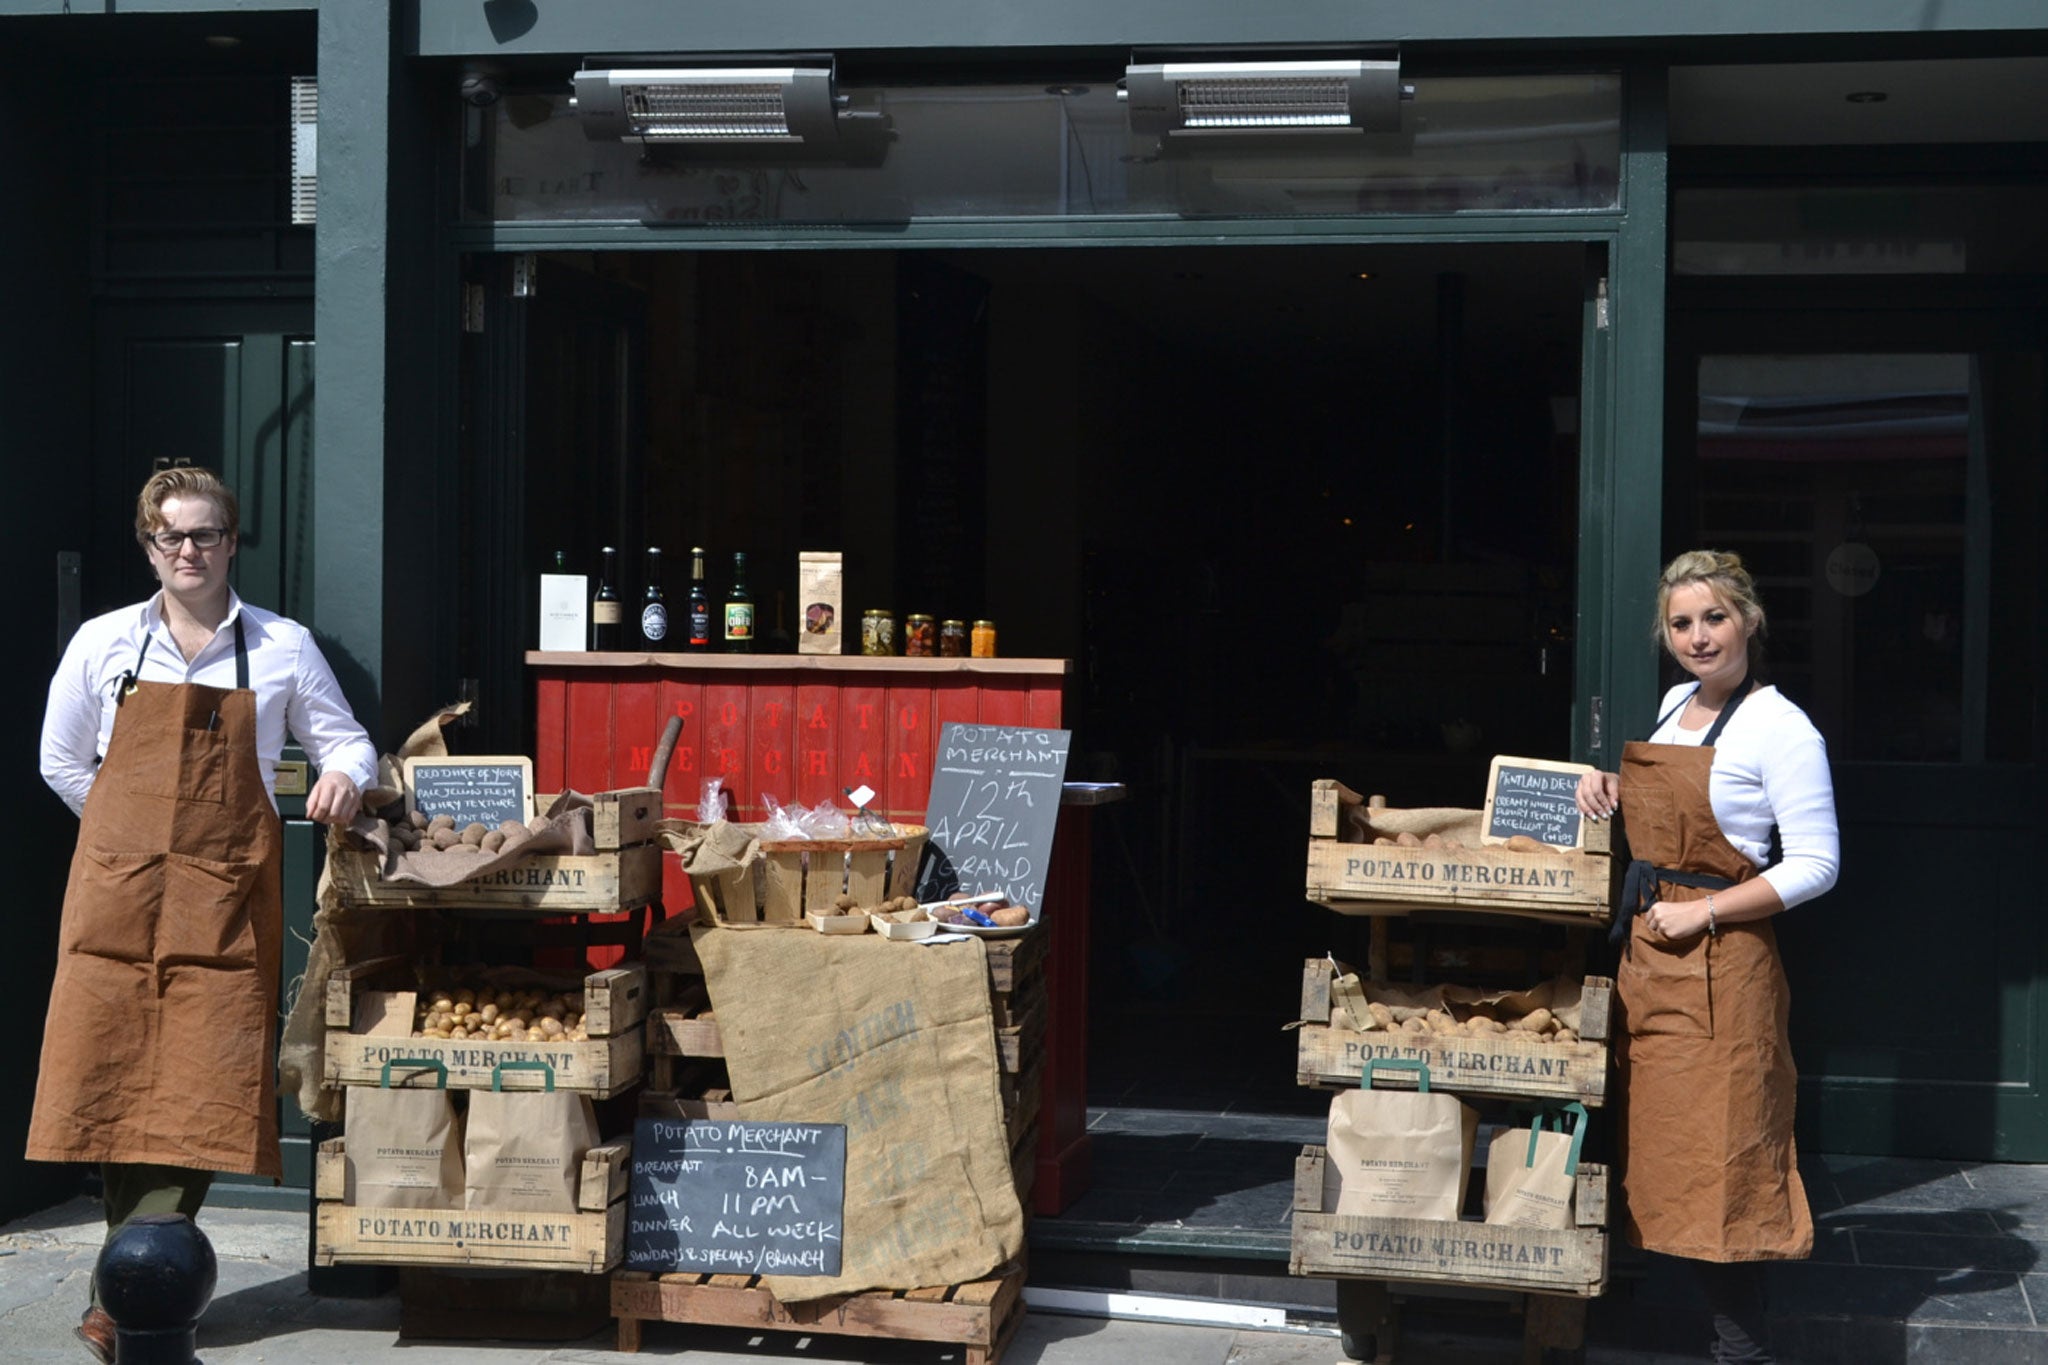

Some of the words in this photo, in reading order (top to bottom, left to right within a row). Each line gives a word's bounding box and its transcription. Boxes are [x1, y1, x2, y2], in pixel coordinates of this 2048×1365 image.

[676, 701, 919, 730] POTATO
[950, 723, 1052, 746] POTATO
[945, 746, 1069, 765] MERCHANT
[416, 768, 440, 779] RED
[491, 767, 522, 783] YORK
[465, 799, 517, 809] TEXTURE
[930, 815, 1029, 851] APRIL
[938, 854, 1032, 882] GRAND
[1345, 858, 1435, 881] POTATO
[1442, 863, 1575, 888] MERCHANT
[363, 1046, 445, 1064] POTATO
[451, 1049, 574, 1070] MERCHANT
[1345, 1042, 1431, 1066] POTATO
[1440, 1050, 1570, 1077] MERCHANT
[653, 1122, 722, 1147] POTATO
[728, 1124, 822, 1151] MERCHANT
[634, 1160, 704, 1177] BREAKFAST
[633, 1188, 681, 1210] LUNCH
[358, 1217, 441, 1238] POTATO
[446, 1220, 571, 1243] MERCHANT
[631, 1215, 694, 1234] DINNER
[711, 1219, 760, 1240] ALL
[767, 1220, 840, 1243] WEEK
[1332, 1231, 1423, 1255] POTATO
[1430, 1237, 1565, 1266] MERCHANT
